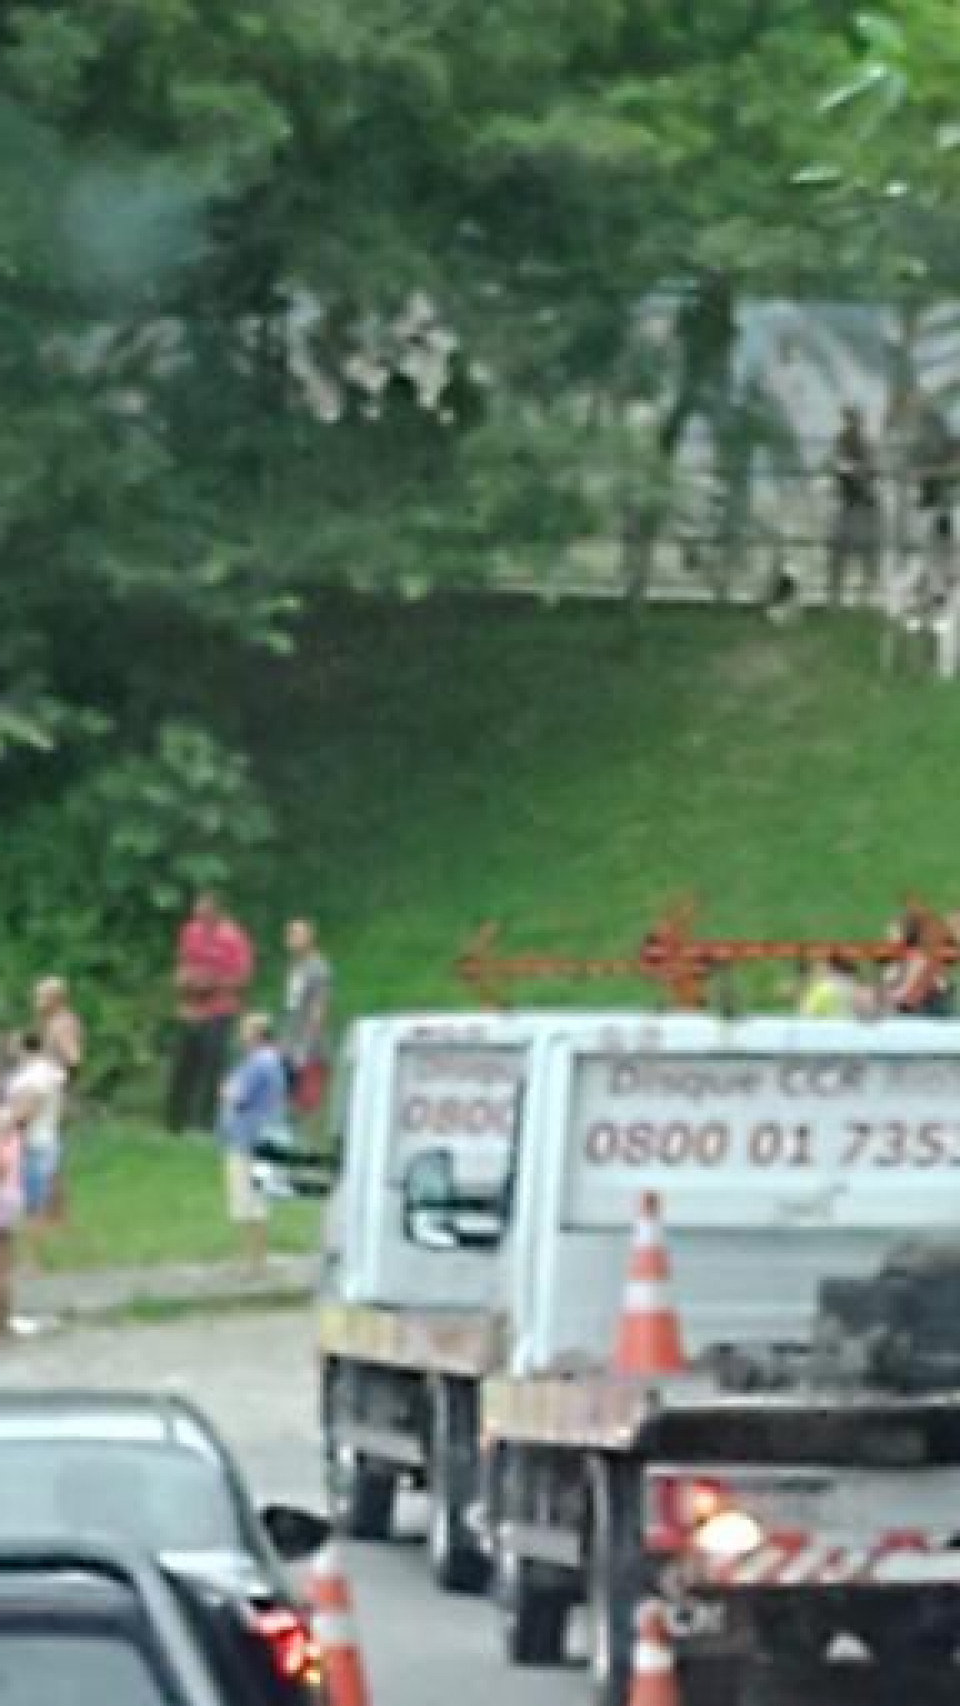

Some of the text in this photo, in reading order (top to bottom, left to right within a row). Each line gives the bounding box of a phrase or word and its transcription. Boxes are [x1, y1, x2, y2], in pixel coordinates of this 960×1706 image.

[611, 1059, 762, 1106] Disque
[779, 1057, 868, 1098] CCR
[586, 1119, 732, 1166] 0800
[748, 1119, 815, 1166] 01
